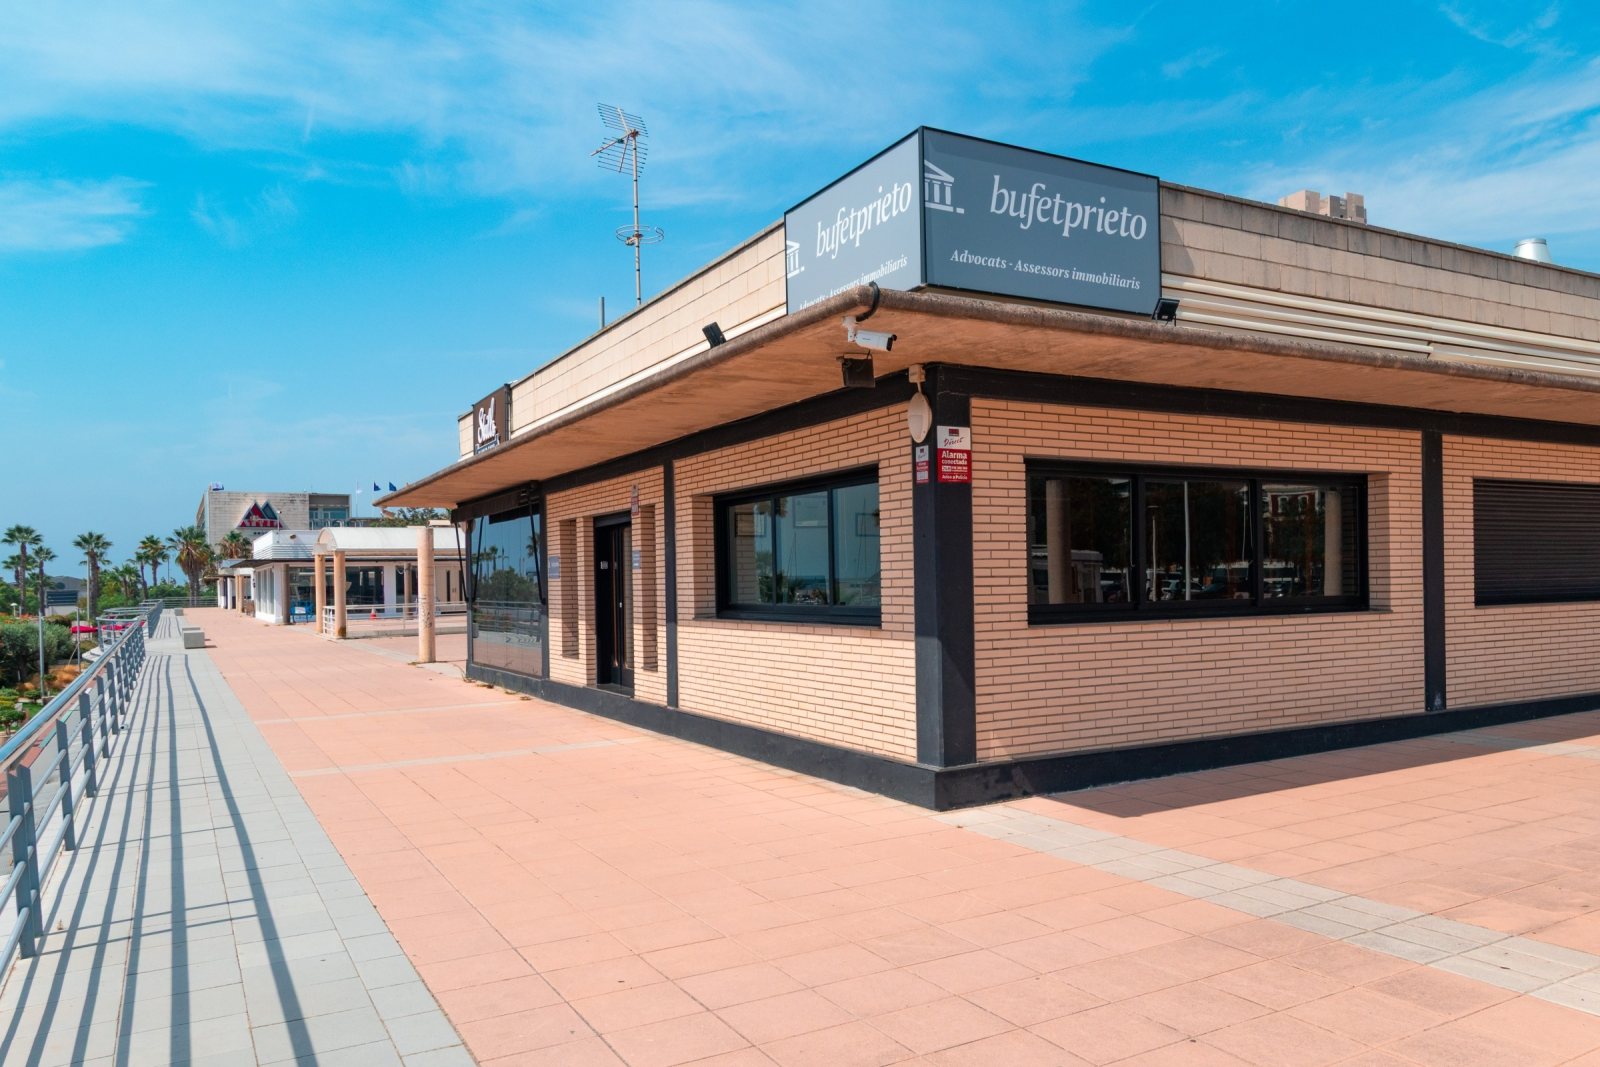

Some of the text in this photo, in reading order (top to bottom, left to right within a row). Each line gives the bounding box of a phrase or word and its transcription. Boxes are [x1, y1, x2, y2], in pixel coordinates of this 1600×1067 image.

[815, 181, 912, 260] bufetprieto
[990, 174, 1148, 241] bufetprieto
[860, 253, 908, 286] immobiliaris
[950, 248, 1007, 269] Advocats
[1014, 259, 1070, 279] Assessors
[1071, 266, 1141, 290] immobiliaris
[942, 450, 967, 459] Alarma
